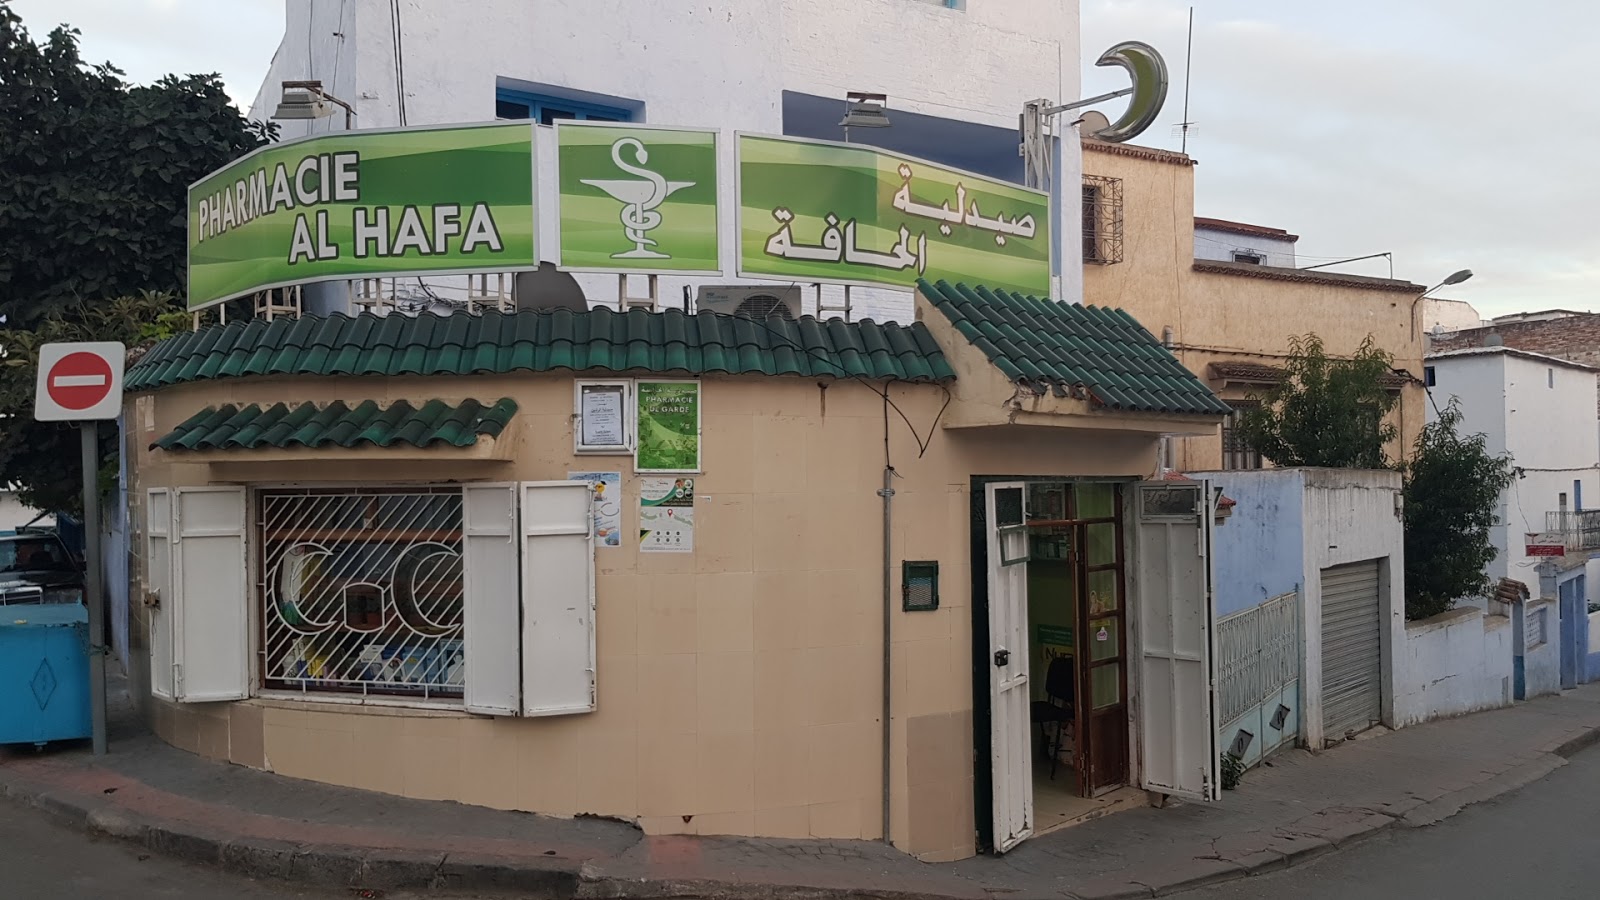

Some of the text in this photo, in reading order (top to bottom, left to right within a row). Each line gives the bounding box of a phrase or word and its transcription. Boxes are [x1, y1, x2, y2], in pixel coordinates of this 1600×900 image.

[198, 152, 360, 242] PHARMACIE
[289, 203, 503, 264] AL HAFA
[892, 163, 1036, 246] صيدلية
[764, 207, 927, 276] الحافة
